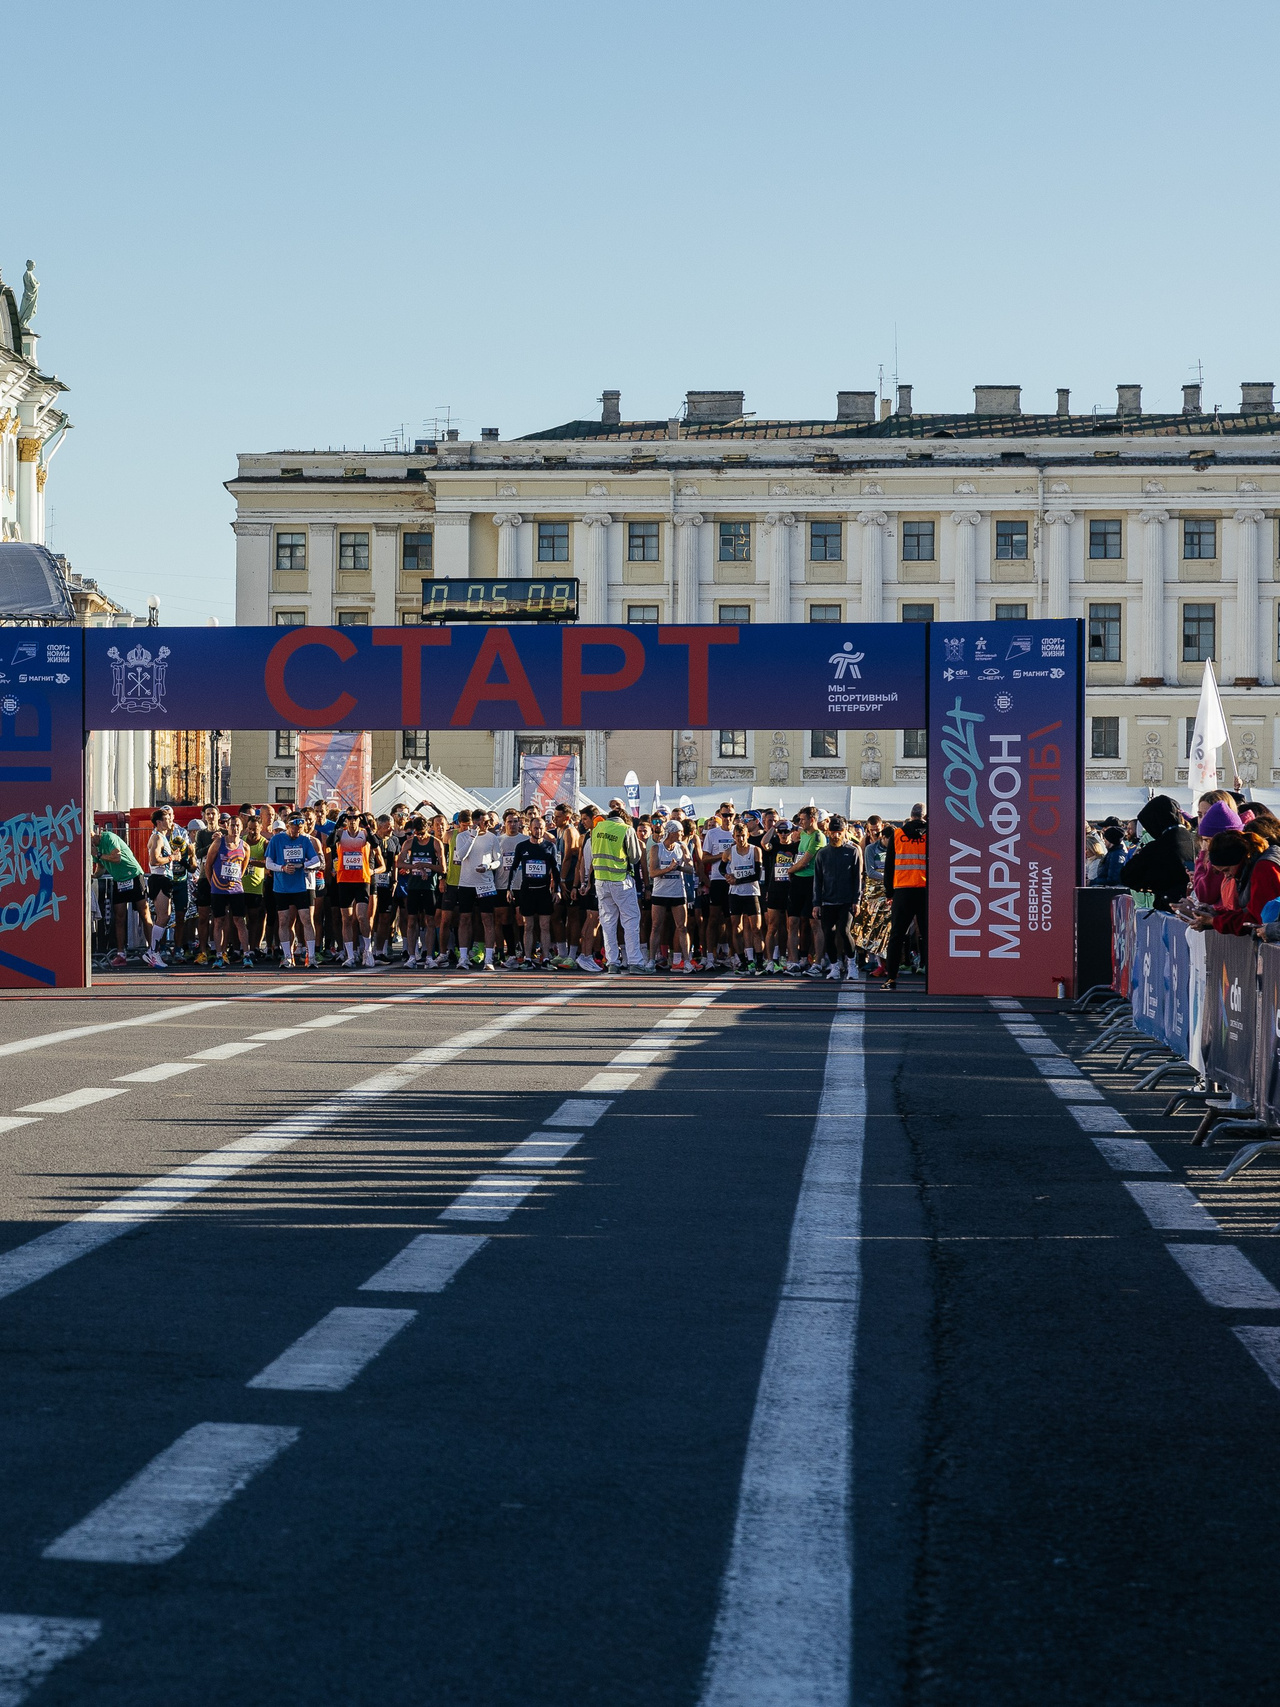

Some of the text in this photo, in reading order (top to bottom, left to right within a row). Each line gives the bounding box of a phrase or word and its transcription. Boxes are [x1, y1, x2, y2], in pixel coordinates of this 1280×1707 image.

[264, 626, 739, 728] СТАРТ
[828, 692, 898, 702] СПОРТИВНЫЙ
[828, 704, 883, 712] ПЕТЕРБУРГ
[940, 695, 986, 829] 2024
[988, 734, 1022, 959] МАРАФОН
[948, 838, 982, 958] ПОЛУ
[1028, 861, 1039, 932] СЕВЕРНАЯ
[1041, 866, 1054, 932] СТОЛИЦА
